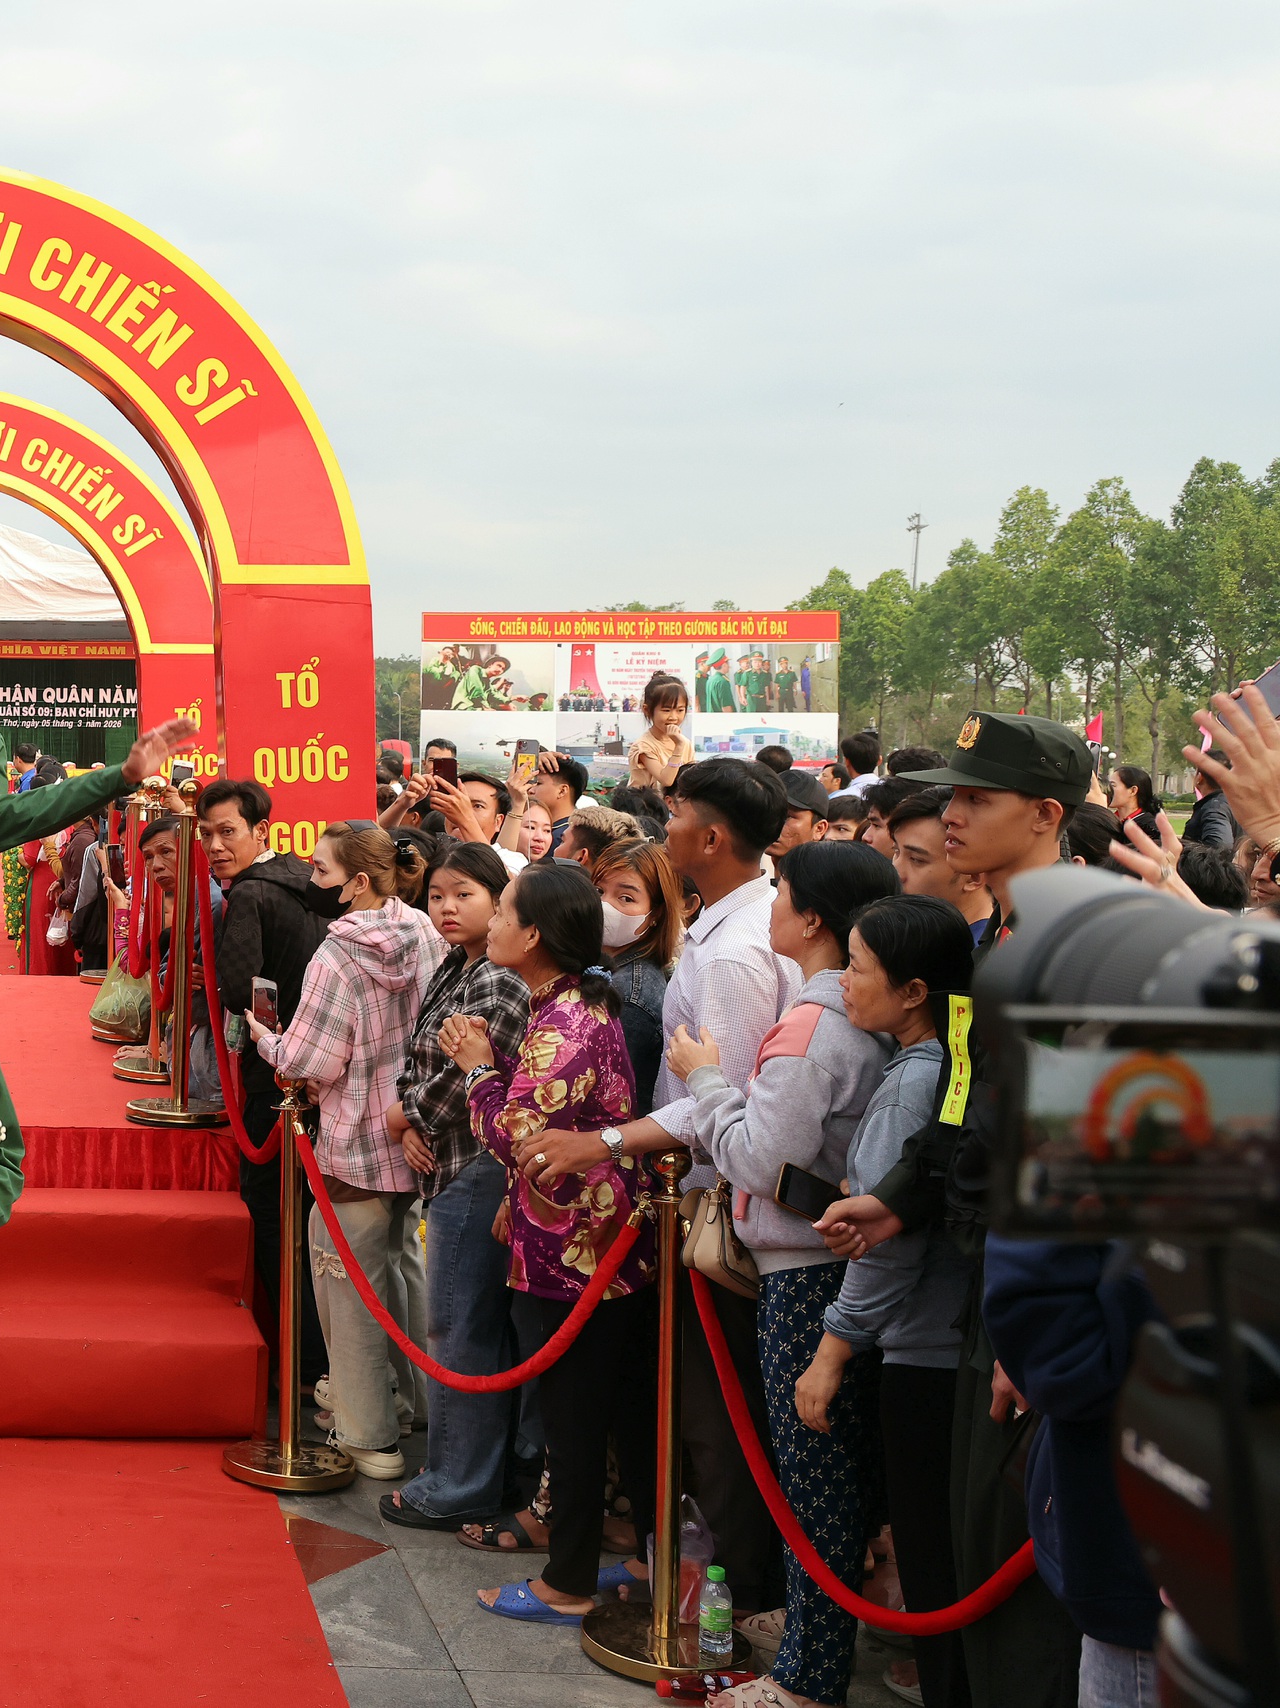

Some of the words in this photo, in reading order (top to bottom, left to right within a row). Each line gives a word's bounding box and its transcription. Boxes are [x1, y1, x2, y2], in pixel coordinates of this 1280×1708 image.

[29, 237, 195, 370] CHIẾN
[175, 357, 259, 426] SĨ
[21, 437, 125, 522] CHIẾN
[111, 513, 165, 557] SĨ
[470, 616, 498, 638] SỐNG,
[500, 616, 528, 636] CHIẾN
[530, 616, 552, 638] ĐẤU,
[554, 621, 572, 636] LAO
[574, 616, 600, 639] ĐỘNG
[603, 616, 615, 636] VÀ
[617, 621, 636, 639] HỌC
[638, 617, 656, 639] TẬP
[658, 621, 683, 636] THEO
[684, 618, 718, 636] GƯƠNG
[721, 616, 739, 636] BÁC
[741, 616, 755, 636] HỒ
[757, 616, 768, 636] VĨ
[769, 620, 788, 639] ĐẠI
[39, 644, 79, 657] VIỆT
[85, 645, 126, 655] NAM
[42, 684, 94, 704] QUÂN
[99, 684, 138, 704] NĂM
[275, 656, 320, 708] TỔ
[3, 718, 20, 728] Thơ,
[22, 719, 40, 729] ngày
[52, 719, 74, 729] tháng
[86, 720, 102, 728] năm
[104, 720, 122, 728] 2026
[22, 703, 36, 717] SỐ
[37, 707, 53, 717] 09:
[55, 707, 77, 717] BAN
[79, 704, 97, 718] CHỈ
[98, 707, 120, 718] HUY
[123, 708, 137, 718] PT
[160, 745, 219, 780] QỐC
[252, 732, 349, 788] QUỐC
